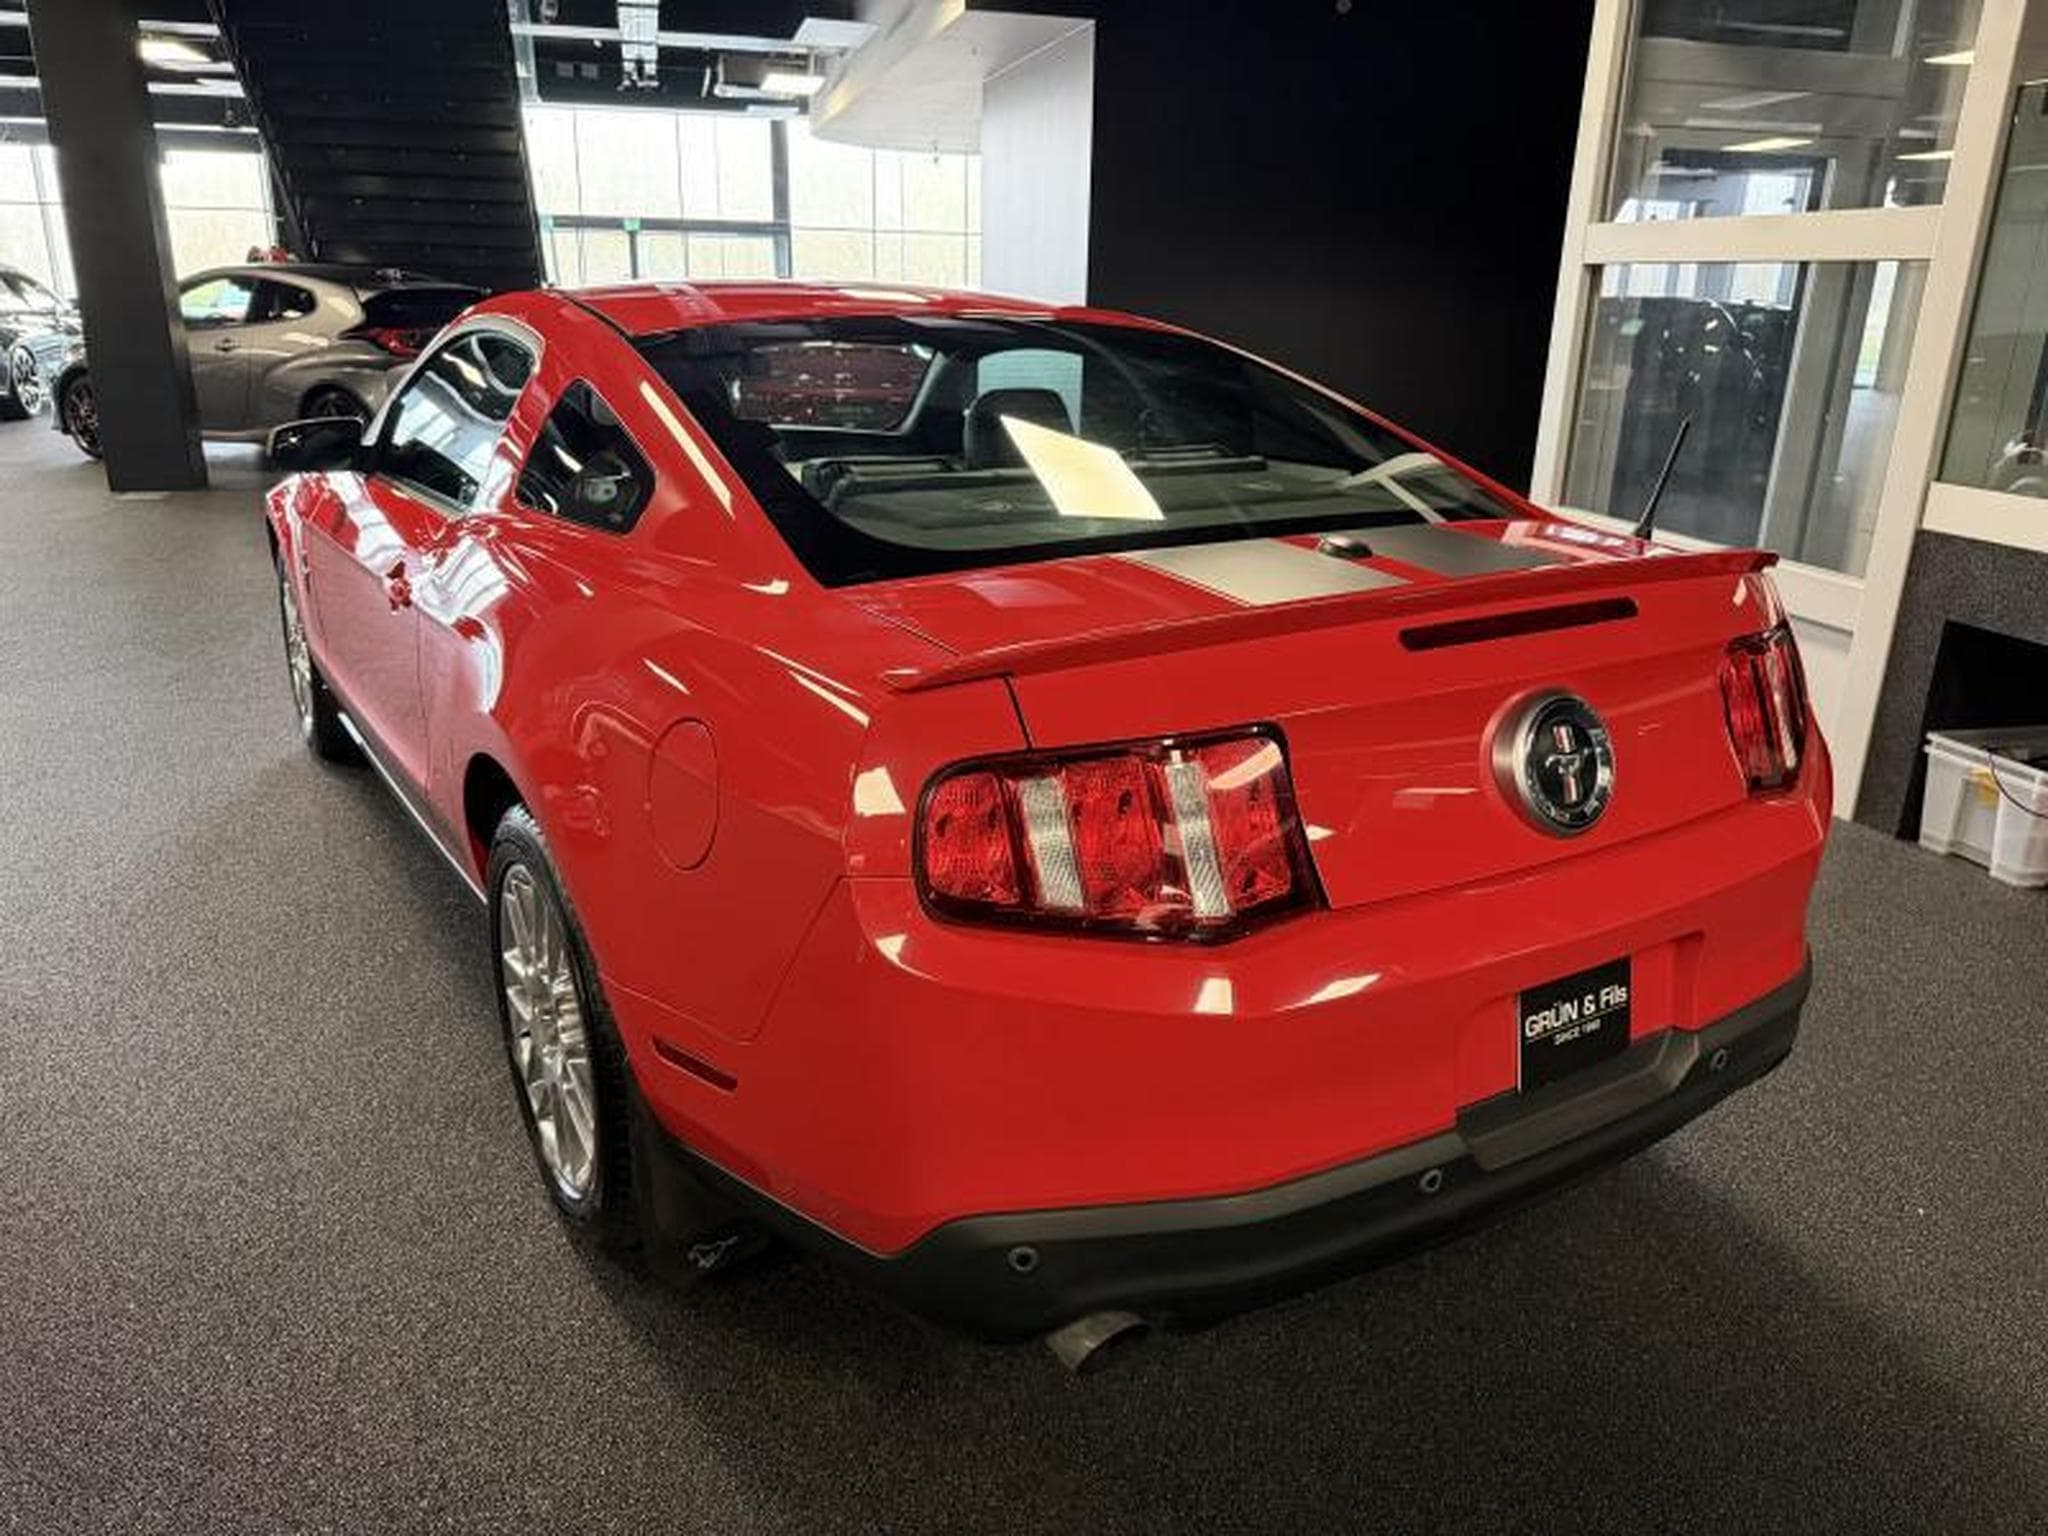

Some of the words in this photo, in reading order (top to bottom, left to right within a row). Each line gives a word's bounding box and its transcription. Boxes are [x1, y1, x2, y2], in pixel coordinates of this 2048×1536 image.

[1525, 1000, 1578, 1038] GRÜN
[1583, 994, 1596, 1015] &
[1599, 984, 1628, 1009] Fils
